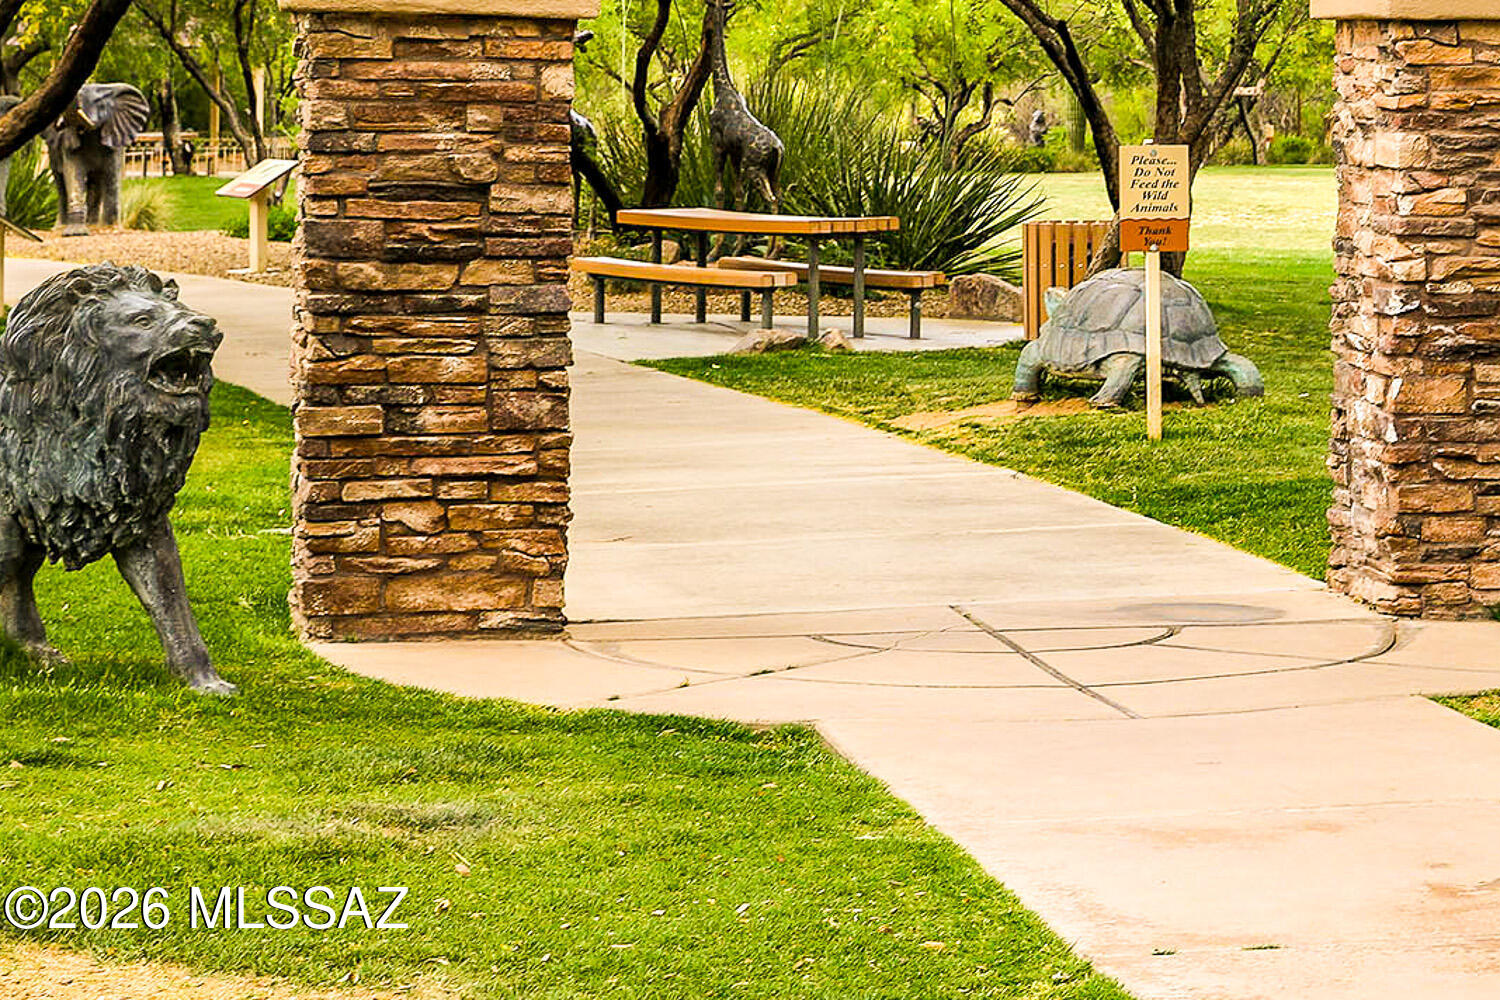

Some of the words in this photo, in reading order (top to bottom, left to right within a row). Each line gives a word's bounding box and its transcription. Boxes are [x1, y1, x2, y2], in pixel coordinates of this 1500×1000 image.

[1130, 155, 1177, 165] Please...
[1133, 167, 1151, 177] Do
[1155, 167, 1175, 177] Not
[1130, 179, 1159, 189] Feed
[1161, 179, 1180, 189] the
[1142, 190, 1169, 200] Wild
[1130, 202, 1178, 213] Animals
[1139, 226, 1172, 235] Thank
[1144, 237, 1167, 247] You!
